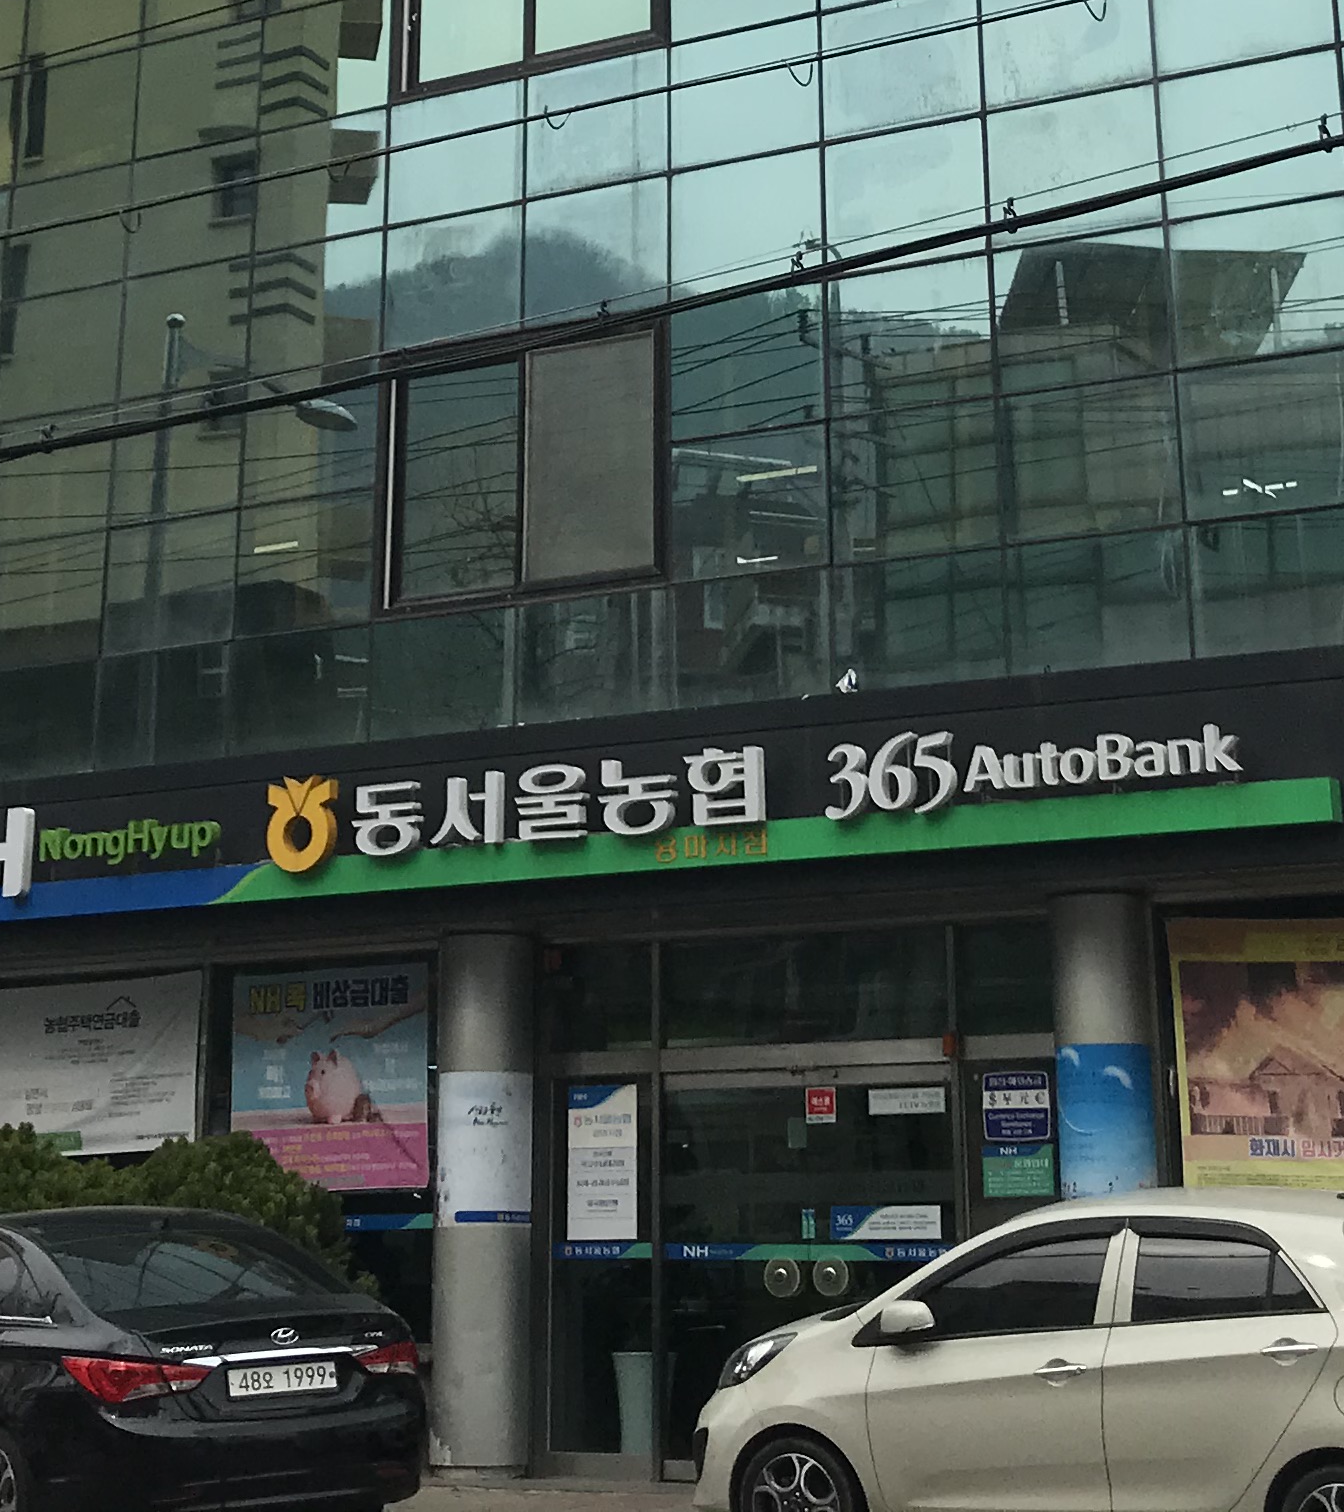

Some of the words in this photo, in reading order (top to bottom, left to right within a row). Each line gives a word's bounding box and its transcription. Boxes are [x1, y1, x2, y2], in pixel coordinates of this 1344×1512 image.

[39, 819, 222, 866] NongHyup
[351, 745, 767, 857] 동서울농협
[824, 730, 958, 821] 365
[962, 723, 1244, 794] AutoBank
[655, 829, 769, 864] 용마지점
[312, 974, 409, 1010] 비상금대출
[1249, 1139, 1296, 1158] 화재시
[834, 1214, 854, 1226] 365
[683, 1245, 709, 1257] NH
[160, 1344, 214, 1355] SONATA
[239, 1371, 275, 1392] 48오
[284, 1366, 327, 1388] 1999
